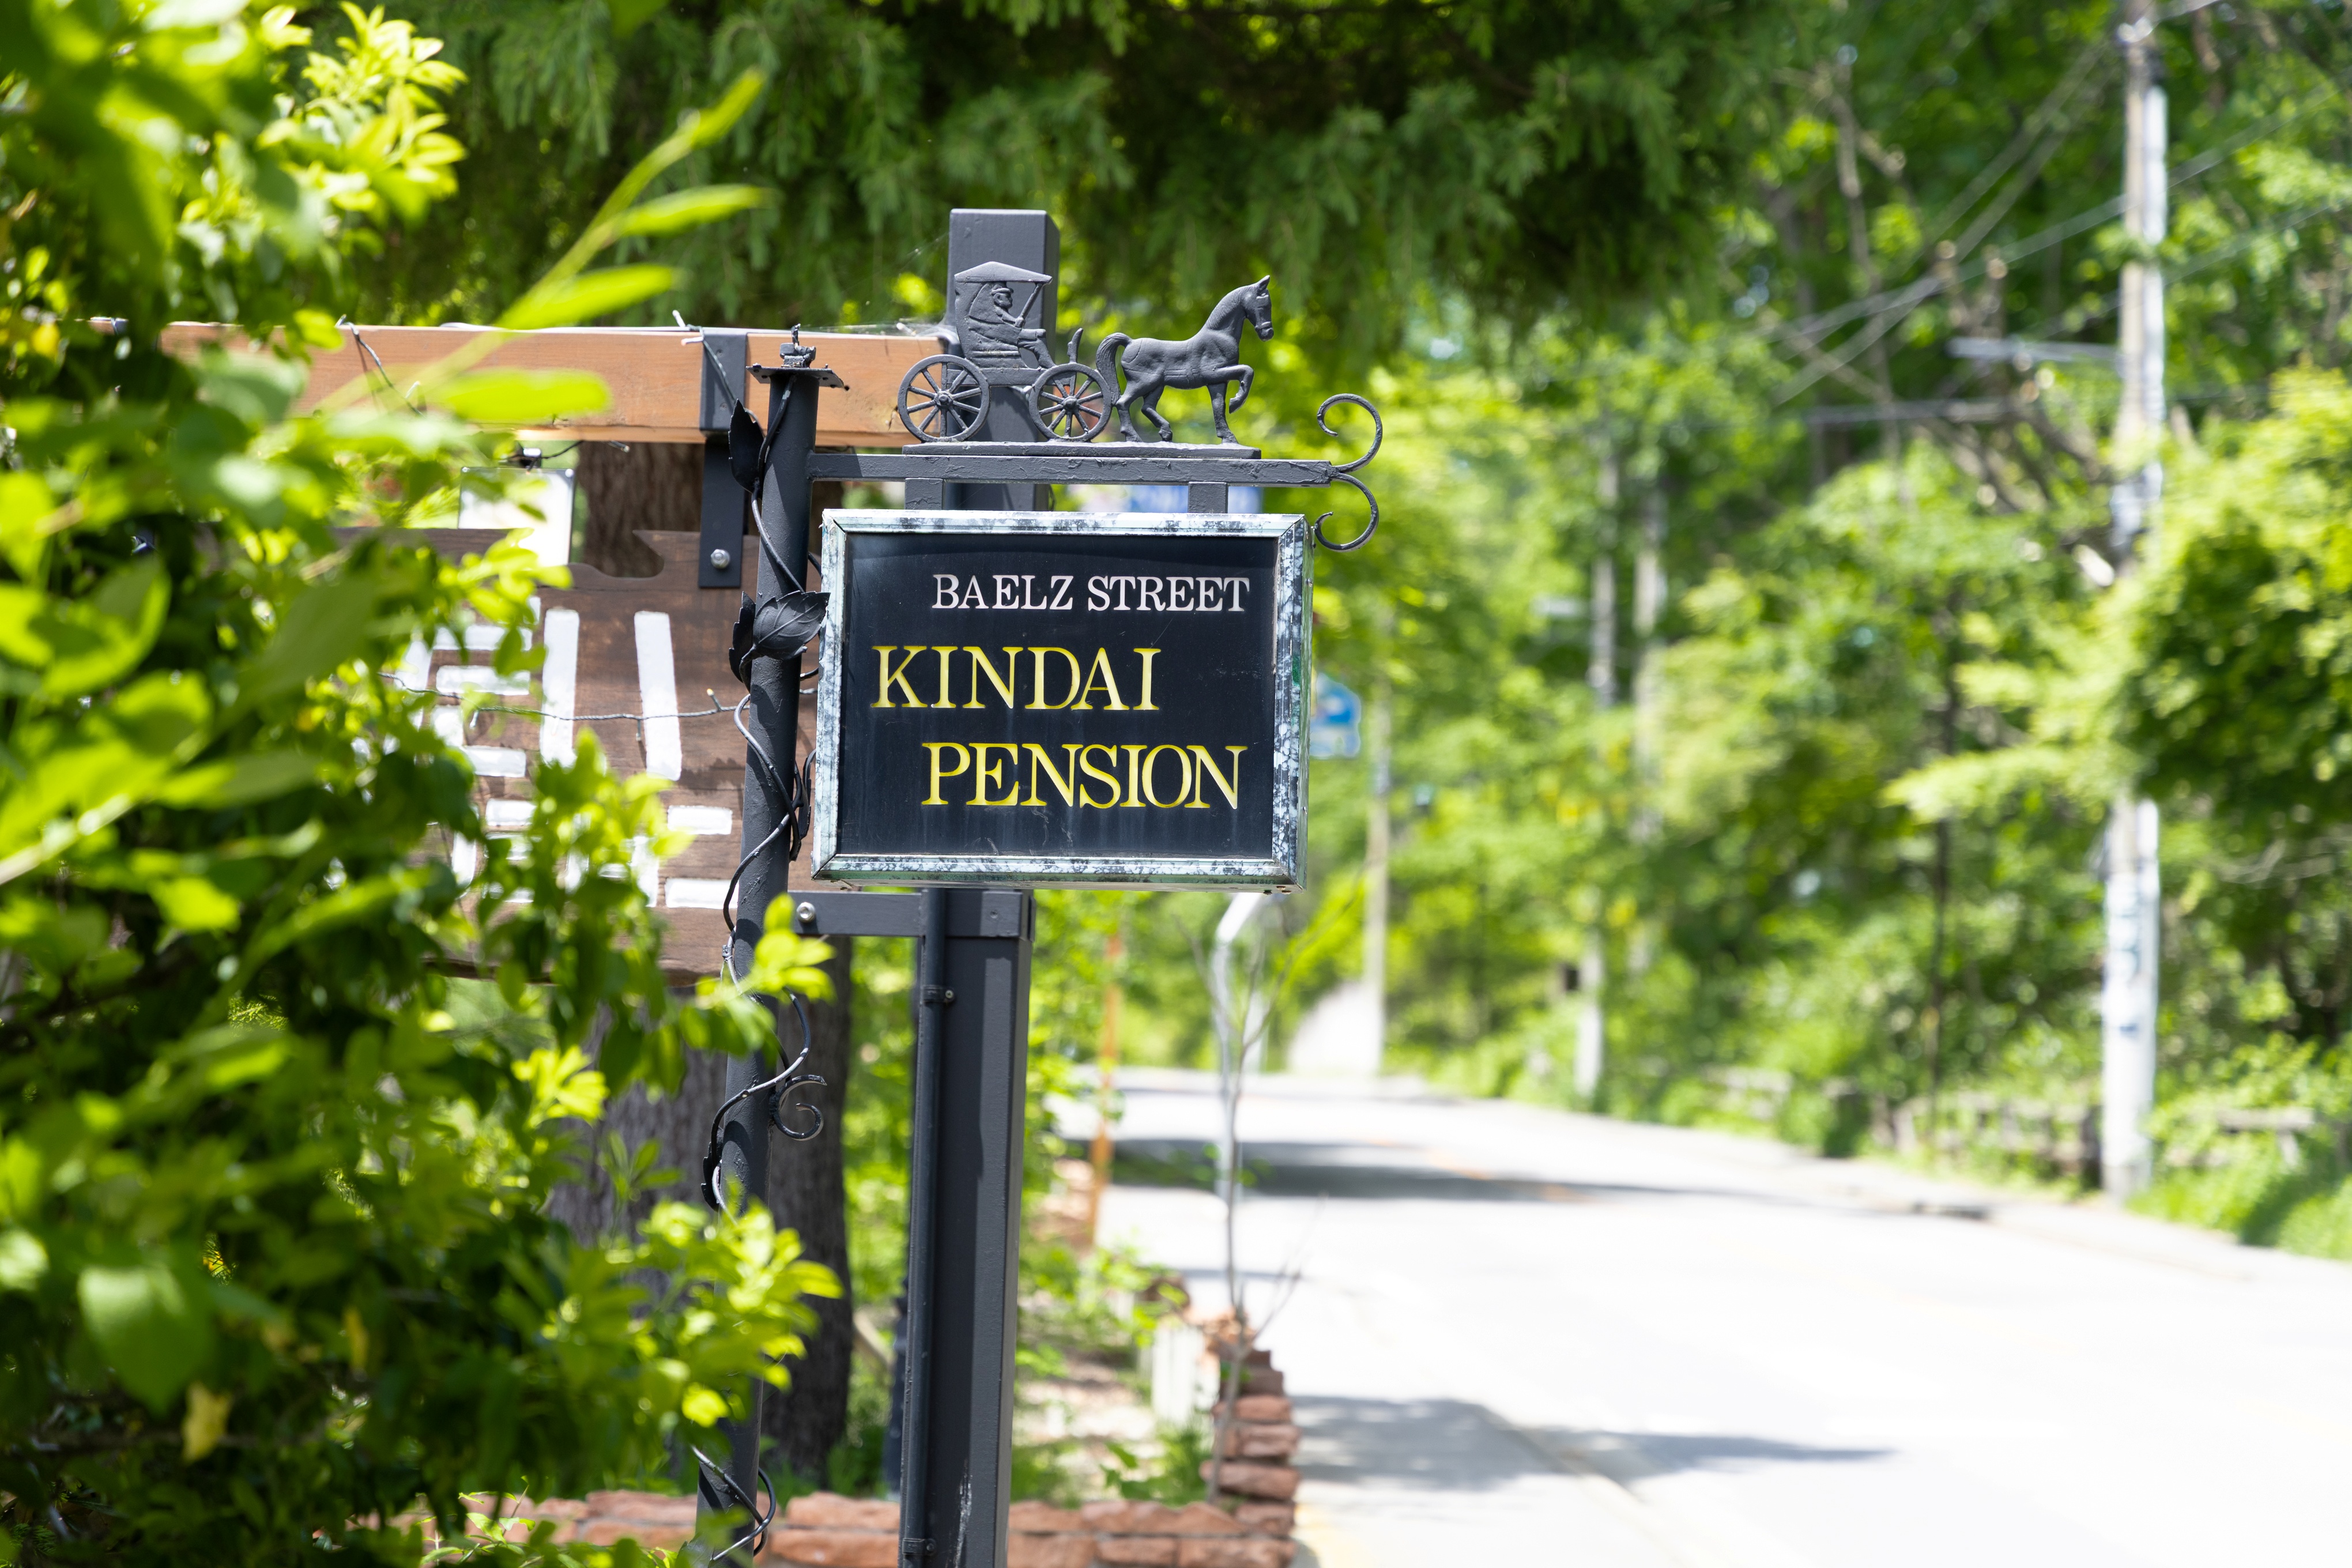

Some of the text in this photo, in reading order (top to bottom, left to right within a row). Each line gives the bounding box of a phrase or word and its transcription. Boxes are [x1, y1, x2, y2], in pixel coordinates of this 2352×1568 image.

[932, 574, 1250, 612] BAELZ STREET
[871, 646, 1161, 711] KINDAI
[922, 742, 1247, 810] PENSION
